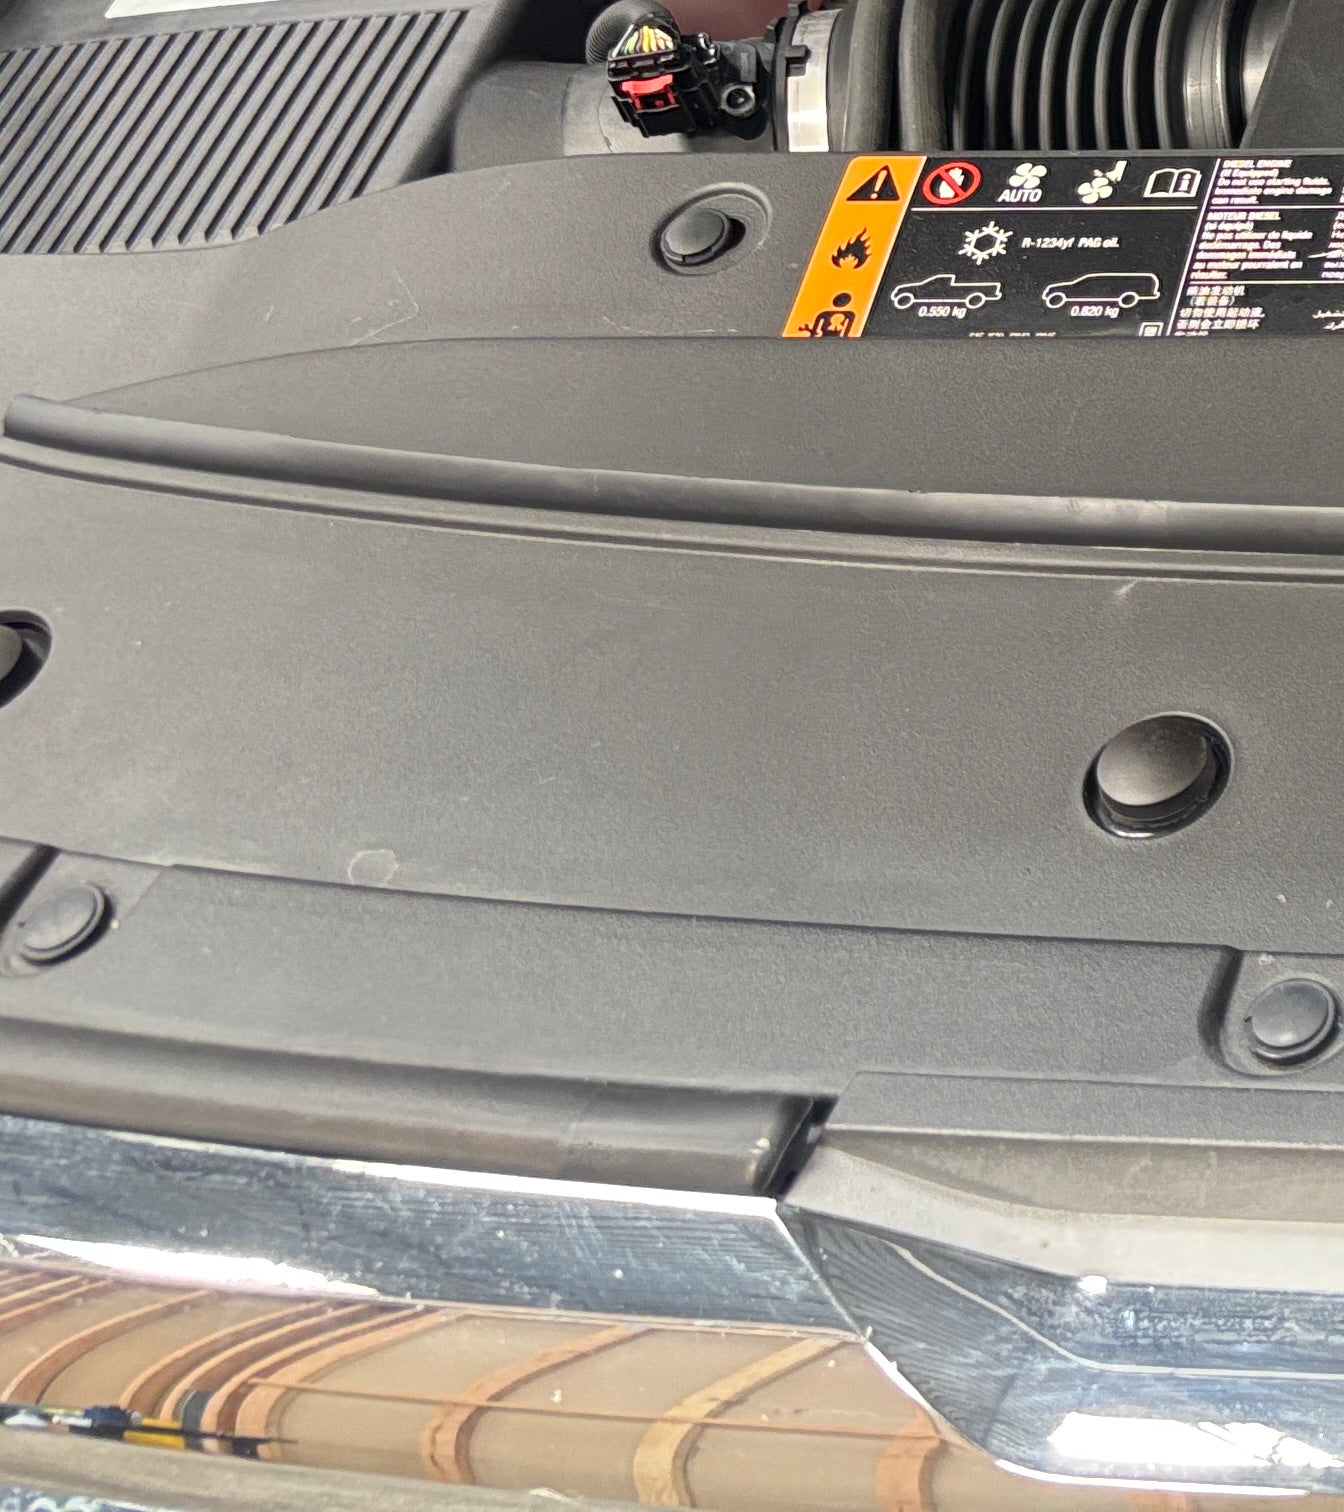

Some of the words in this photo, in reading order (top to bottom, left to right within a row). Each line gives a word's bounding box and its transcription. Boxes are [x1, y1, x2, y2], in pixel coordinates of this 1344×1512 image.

[998, 189, 1042, 202] AUTO
[1206, 211, 1247, 221] MOTEUR
[1248, 211, 1281, 221] DIESEL
[1021, 237, 1074, 250] R-1234yf
[1078, 237, 1102, 248] PAG
[918, 306, 950, 317] 0.550
[952, 306, 967, 319] kg
[1070, 306, 1103, 317] 0.820
[1104, 306, 1120, 319] kg
